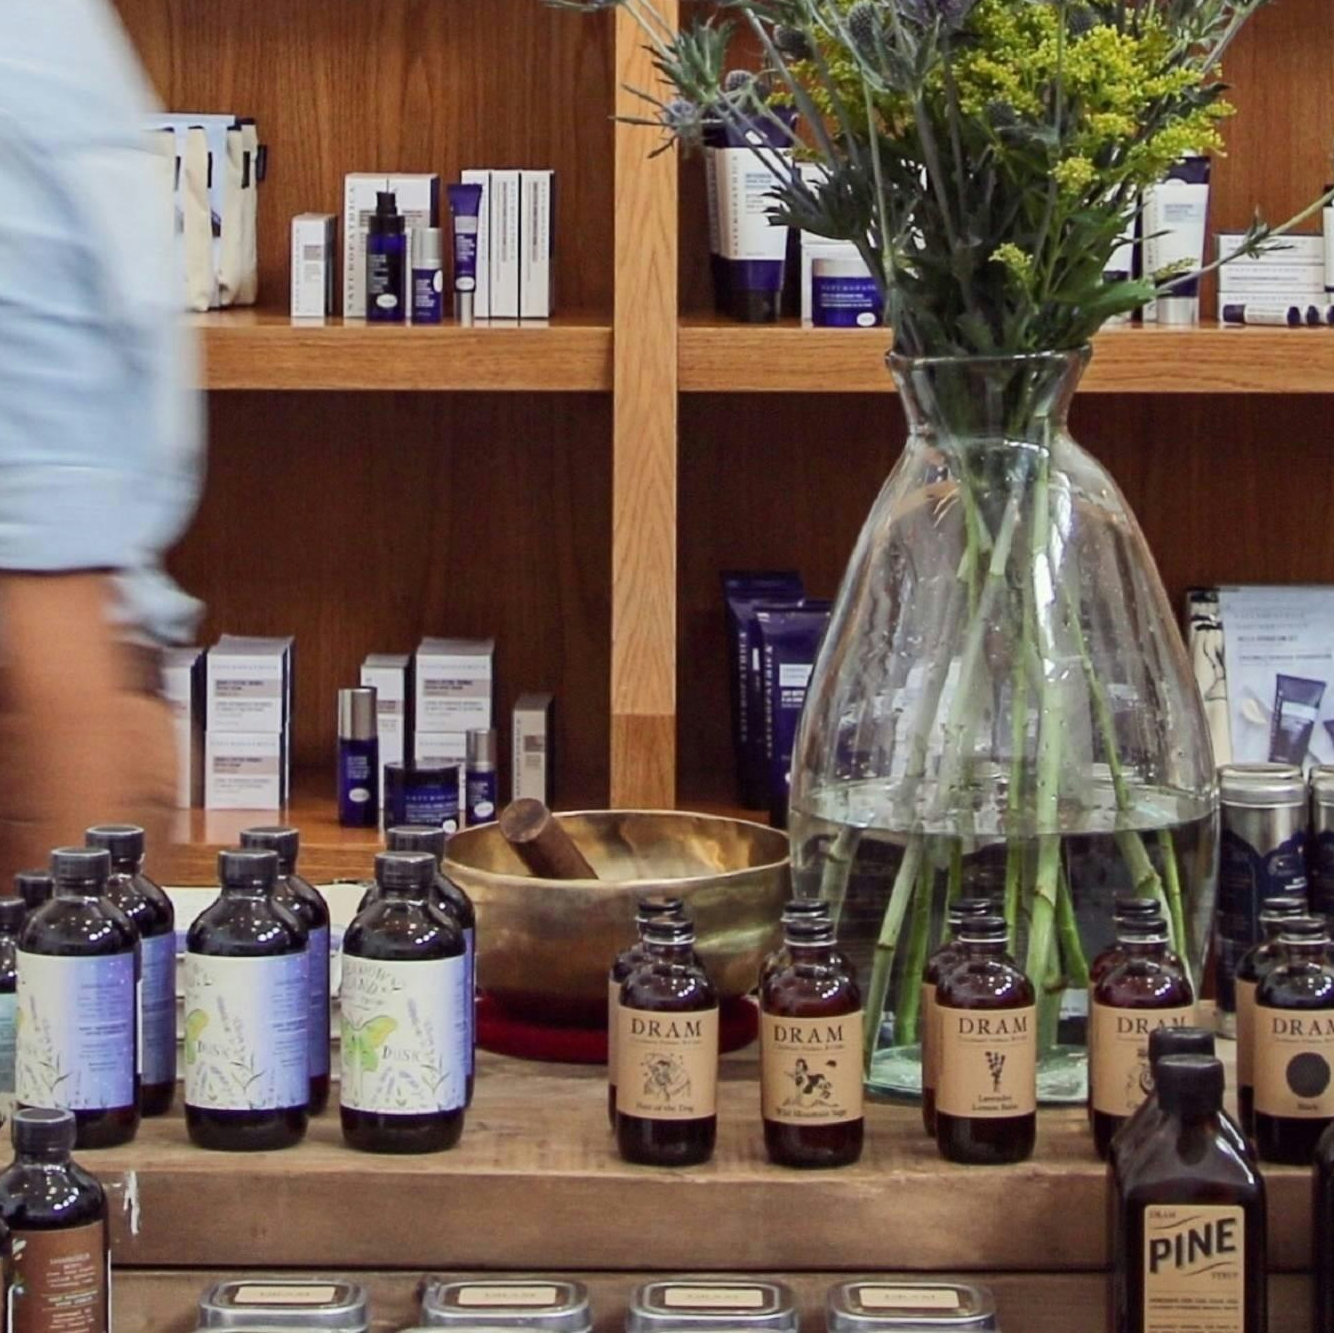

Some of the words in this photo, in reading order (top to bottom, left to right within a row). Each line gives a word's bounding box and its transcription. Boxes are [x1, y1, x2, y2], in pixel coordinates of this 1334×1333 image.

[347, 185, 355, 311] NATUROPATHICA
[630, 1018, 702, 1039] DRAM
[773, 1025, 843, 1043] DRAM
[958, 1016, 1028, 1035] DRAM
[1117, 1017, 1186, 1034] DRAM
[1149, 1217, 1238, 1274] PINE
